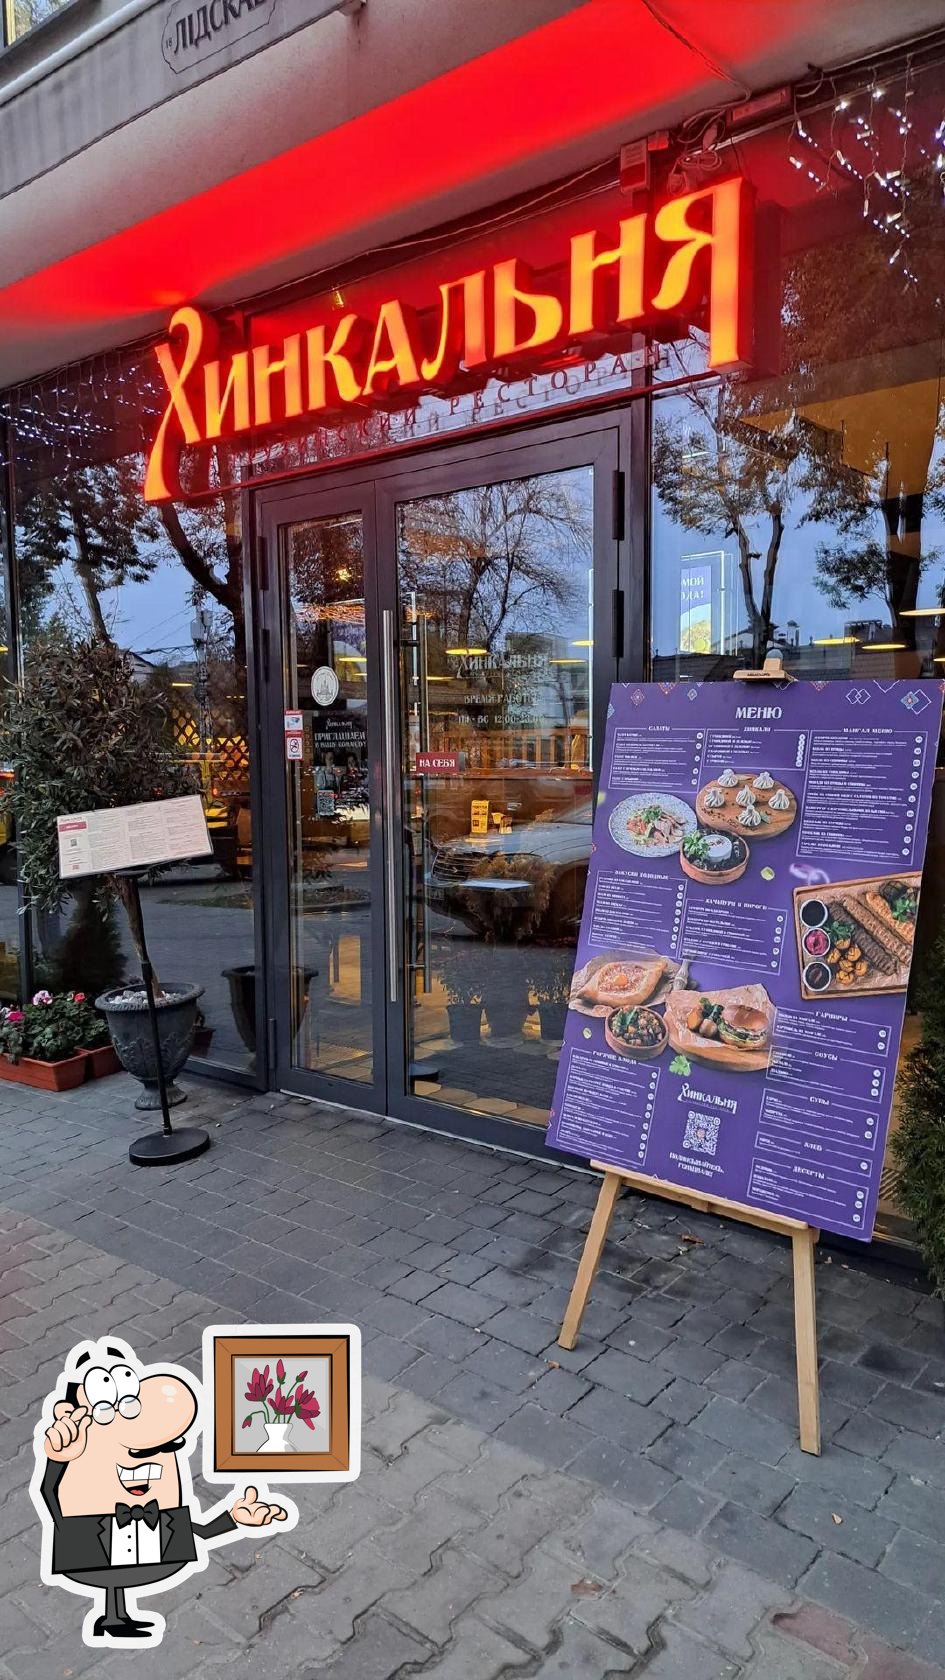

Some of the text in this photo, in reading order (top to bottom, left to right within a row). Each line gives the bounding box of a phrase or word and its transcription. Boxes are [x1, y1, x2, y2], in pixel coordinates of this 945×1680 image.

[143, 176, 744, 502] ХИНКАЛЬНЯ
[735, 706, 783, 720] МЕНЮ
[419, 758, 455, 768] НА СЕБЯ
